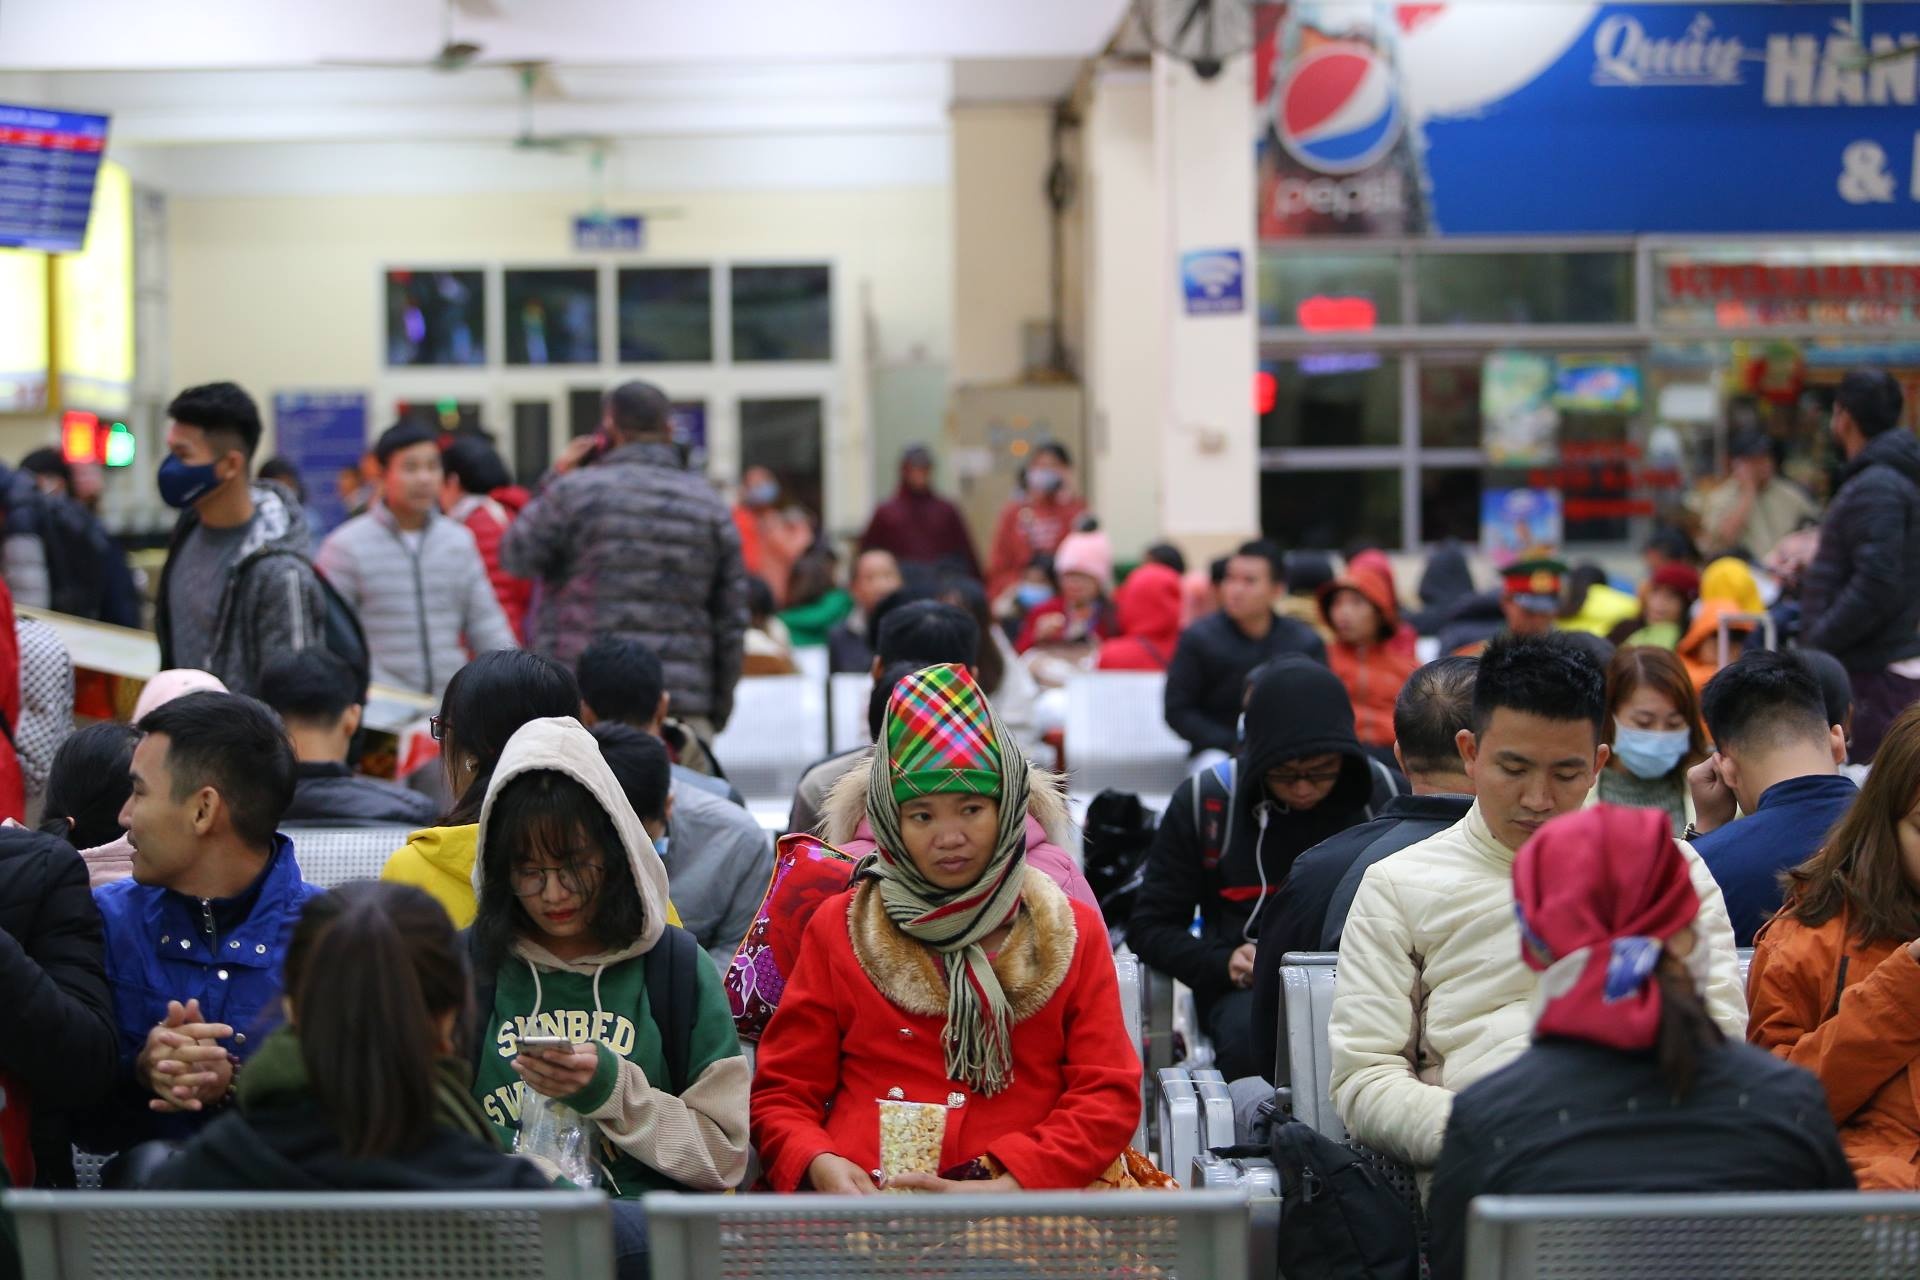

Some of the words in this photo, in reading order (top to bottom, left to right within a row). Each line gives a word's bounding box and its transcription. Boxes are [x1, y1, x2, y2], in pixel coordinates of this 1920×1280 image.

[1273, 170, 1403, 223] pepsi
[1837, 139, 1896, 204] &
[498, 1009, 636, 1058] SUNBED
